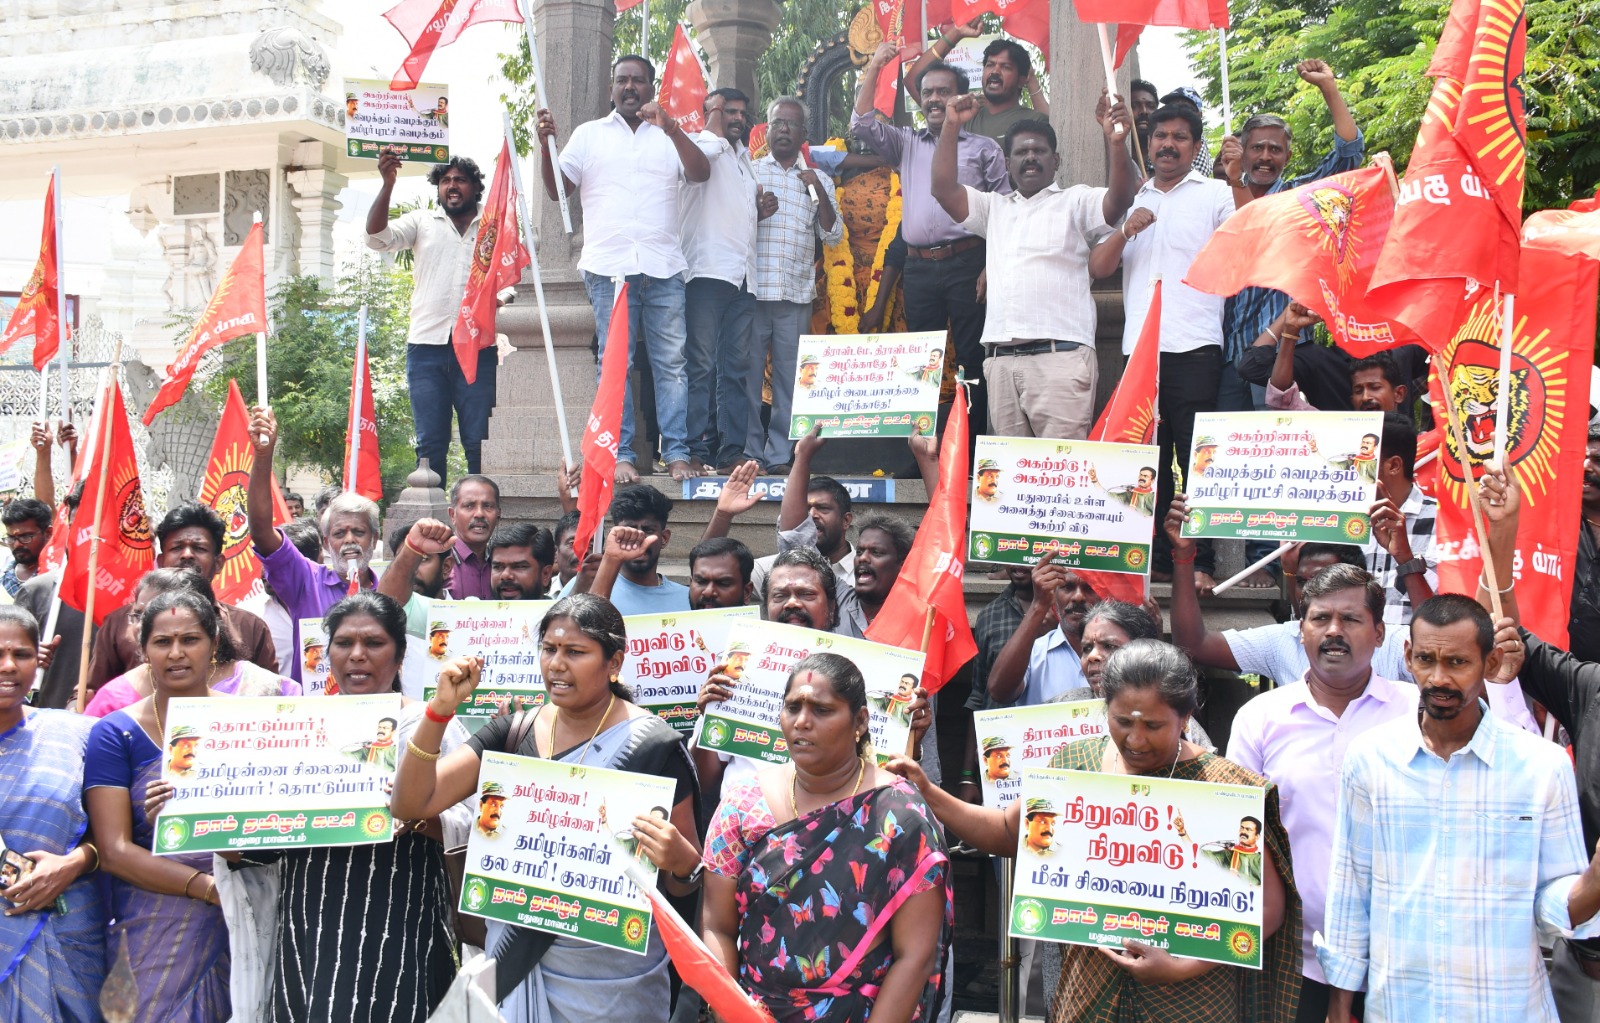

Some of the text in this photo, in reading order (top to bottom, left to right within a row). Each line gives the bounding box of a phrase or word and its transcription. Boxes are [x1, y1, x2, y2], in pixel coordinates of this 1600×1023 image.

[809, 387, 840, 400] தமிழர்
[1228, 430, 1312, 444] அகற்றினால்
[1226, 444, 1311, 458] அகற்றினால்
[1016, 457, 1079, 473] அகற்றிடு
[1204, 463, 1358, 483] வெடிக்கும் வெடிக்கும்
[1013, 472, 1075, 488] அகற்றிடு
[1017, 492, 1106, 507] மதுரையில் உள்ள
[1193, 482, 1366, 503] தமிழர் புரட்சி வெடிக்கும்
[998, 504, 1125, 523] அனைத்து சிலைகளையும்
[1209, 511, 1339, 529] நாம் தமிழர் கட்சி
[1028, 520, 1089, 535] அகற்றி விடு
[998, 538, 1120, 557] நாம் தமிழர் கட்சி
[636, 655, 707, 679] நிறுவிடு
[633, 684, 697, 698] சிலையை
[714, 702, 755, 718] சிலையை
[209, 718, 315, 734] தொட்டுப்பார்
[1022, 723, 1103, 743] திராவிடமே
[204, 736, 311, 751] தொட்டுப்பார்
[733, 727, 770, 745] நாம்
[197, 761, 362, 780] தமிழன்னை சிலையை
[278, 778, 374, 797] தொட்டுப்பார்
[512, 782, 581, 806] தமிழன்னை
[527, 808, 596, 832] தமிழன்னை
[1063, 795, 1159, 832] நிறுவிடு
[193, 812, 356, 836] நாம் தமிழர் கட்சி
[228, 833, 307, 847] மதுரை மாவட்டம்
[514, 833, 612, 866] தமிழர்களின்
[1087, 832, 1184, 869] நிறுவிடு
[481, 853, 510, 871] குல
[512, 859, 549, 879] சாமி
[560, 869, 625, 896] குலசாமி
[1031, 864, 1070, 889] மீன்
[1075, 870, 1165, 899] சிலையை
[491, 886, 619, 927] நாம் தமிழர் கட்சி
[517, 911, 579, 933] மதுரை மாவட்டம்
[1052, 906, 1220, 941] நாம் தமிழர் கட்சி
[1088, 932, 1122, 944] மதுரை
